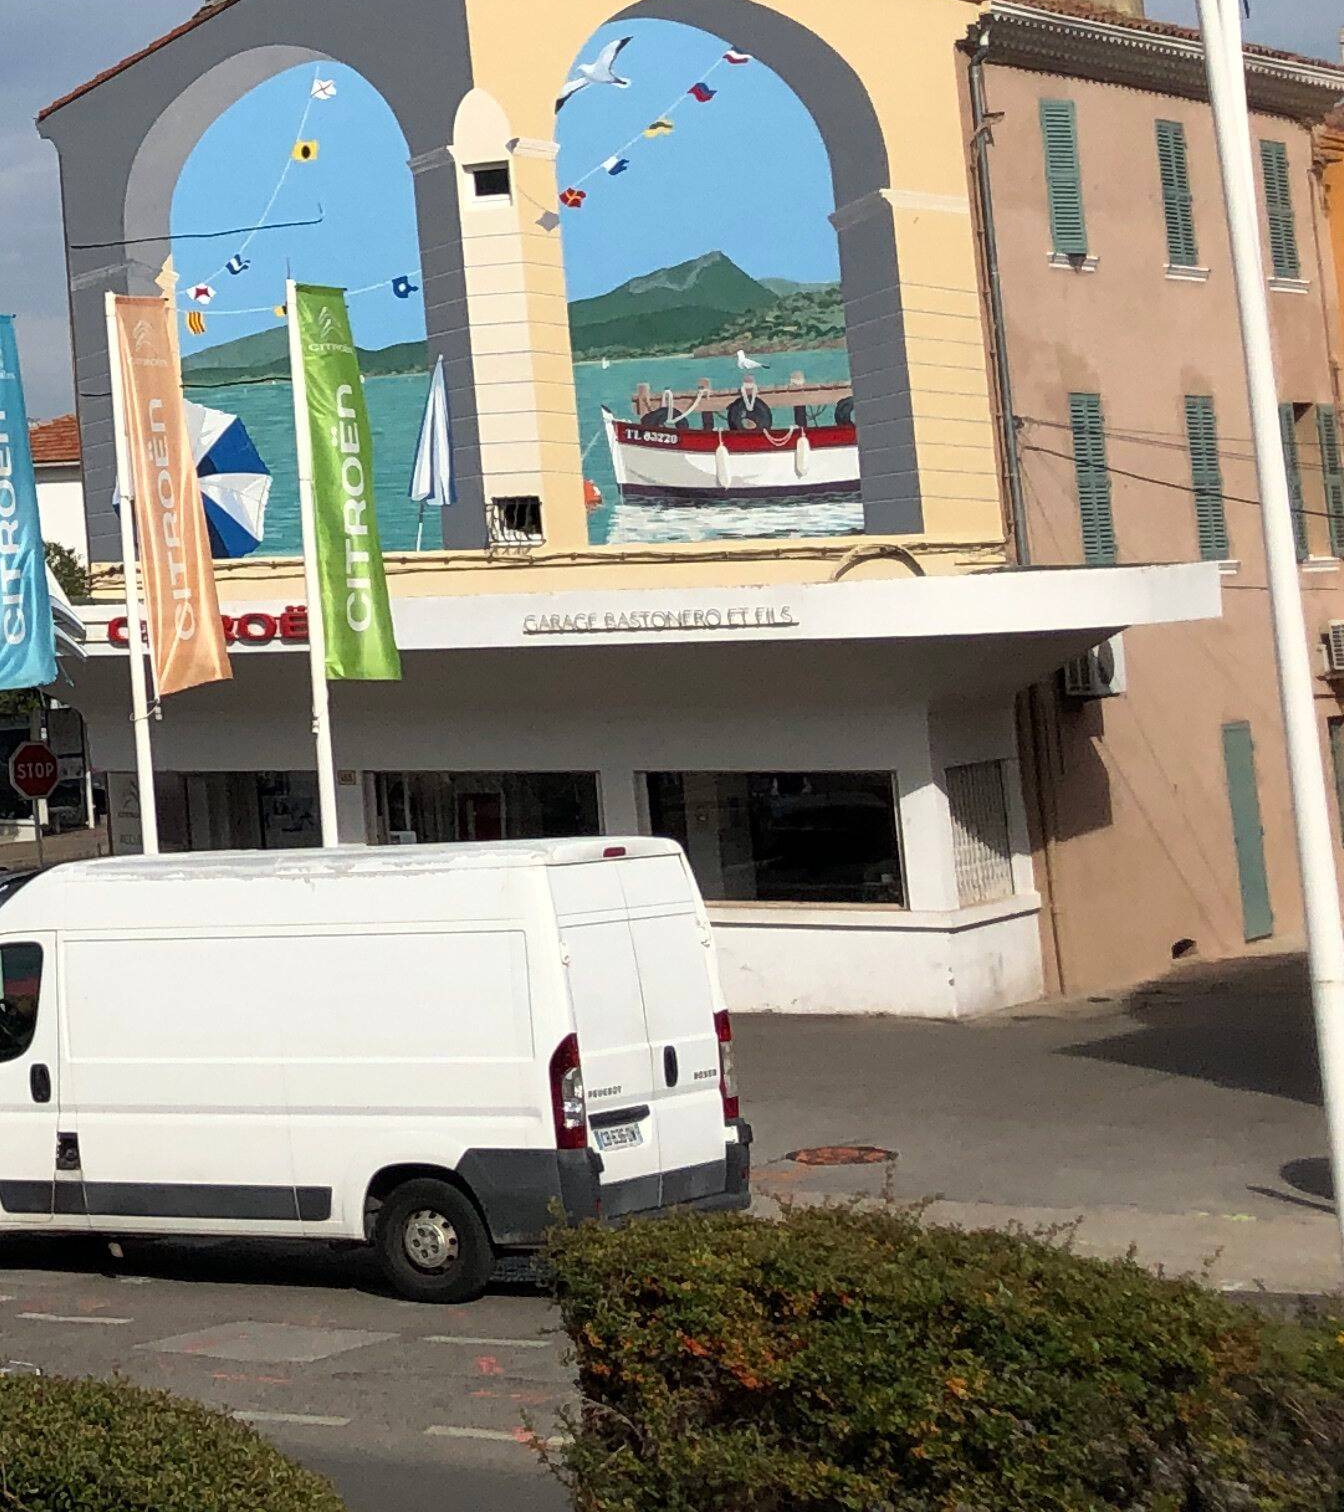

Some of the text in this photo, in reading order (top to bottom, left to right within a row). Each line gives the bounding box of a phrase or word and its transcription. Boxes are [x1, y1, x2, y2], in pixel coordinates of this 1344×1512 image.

[625, 428, 642, 441] TL
[147, 399, 195, 641] CITROËN
[331, 383, 371, 633] CITROËN
[523, 606, 793, 632] GARAGE BASTONERO ET FILS
[16, 762, 54, 780] STOP
